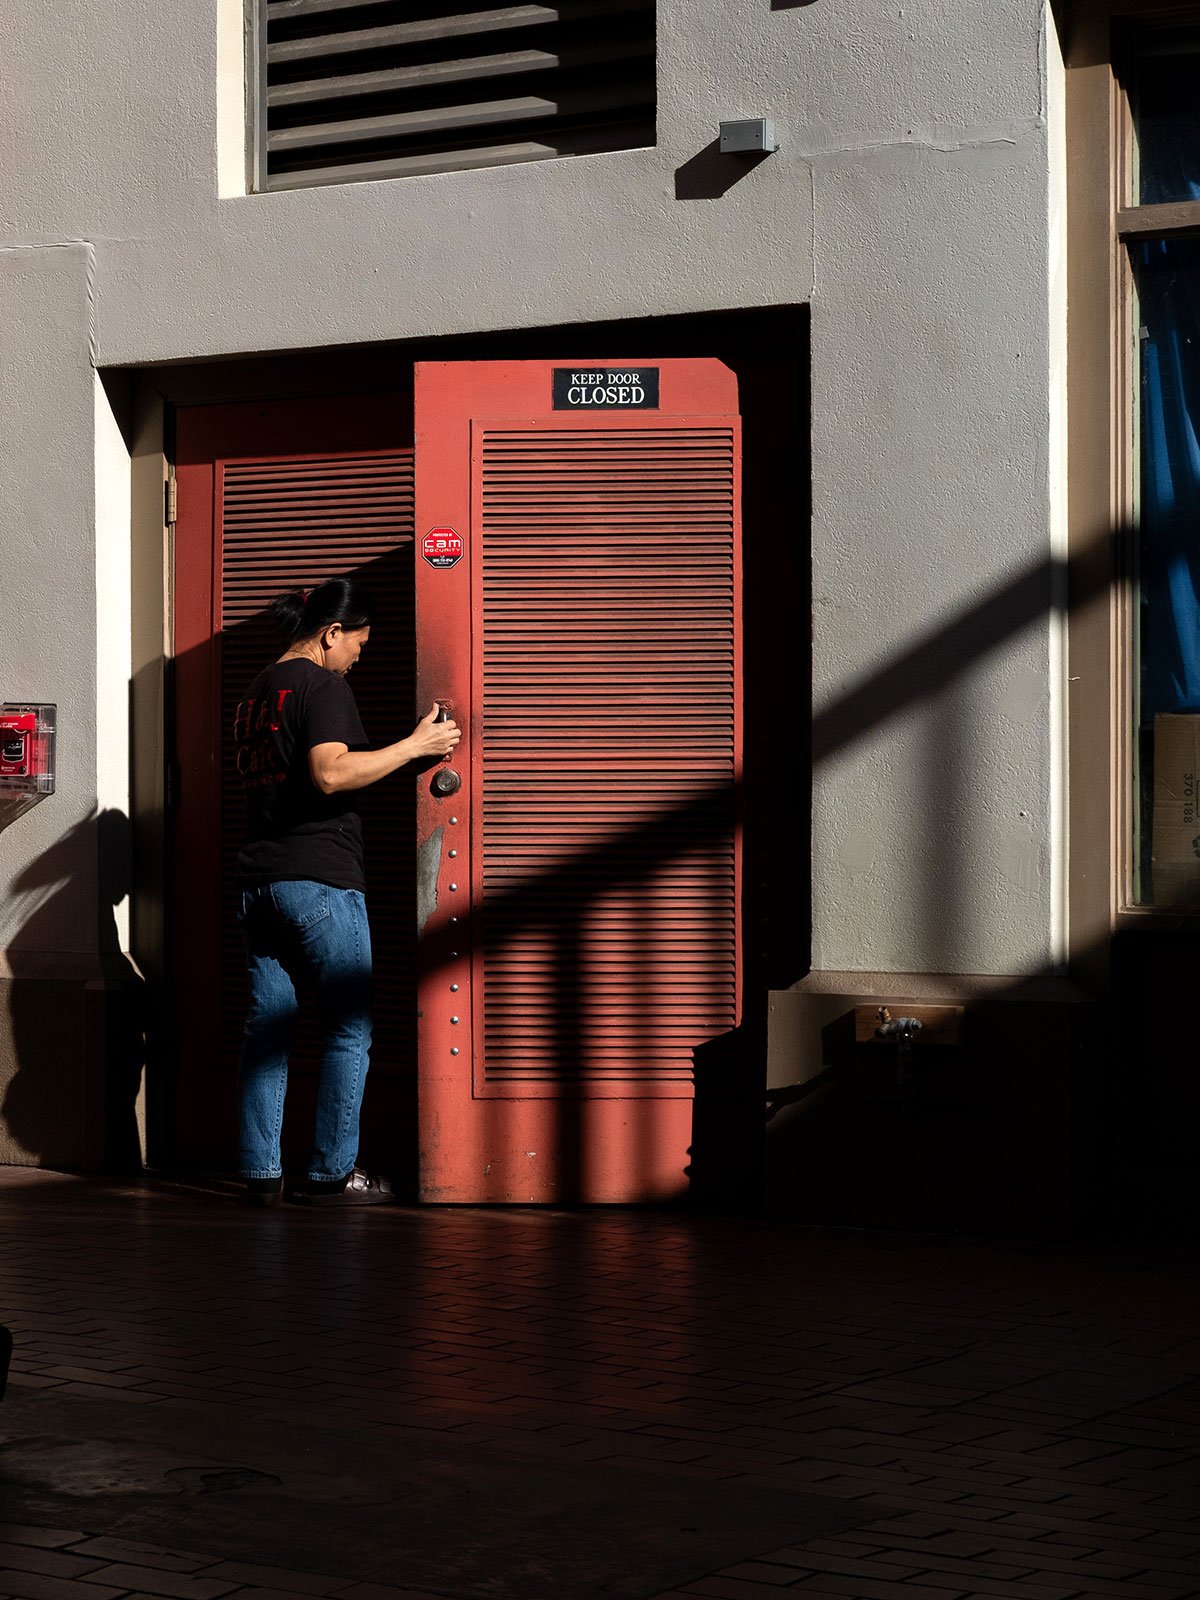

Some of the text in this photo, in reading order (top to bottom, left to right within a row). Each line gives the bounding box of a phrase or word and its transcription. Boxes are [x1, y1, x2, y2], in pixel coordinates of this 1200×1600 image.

[571, 374, 641, 384] KEEP DOOR
[567, 387, 645, 404] CLOSED
[1184, 773, 1194, 796] 370
